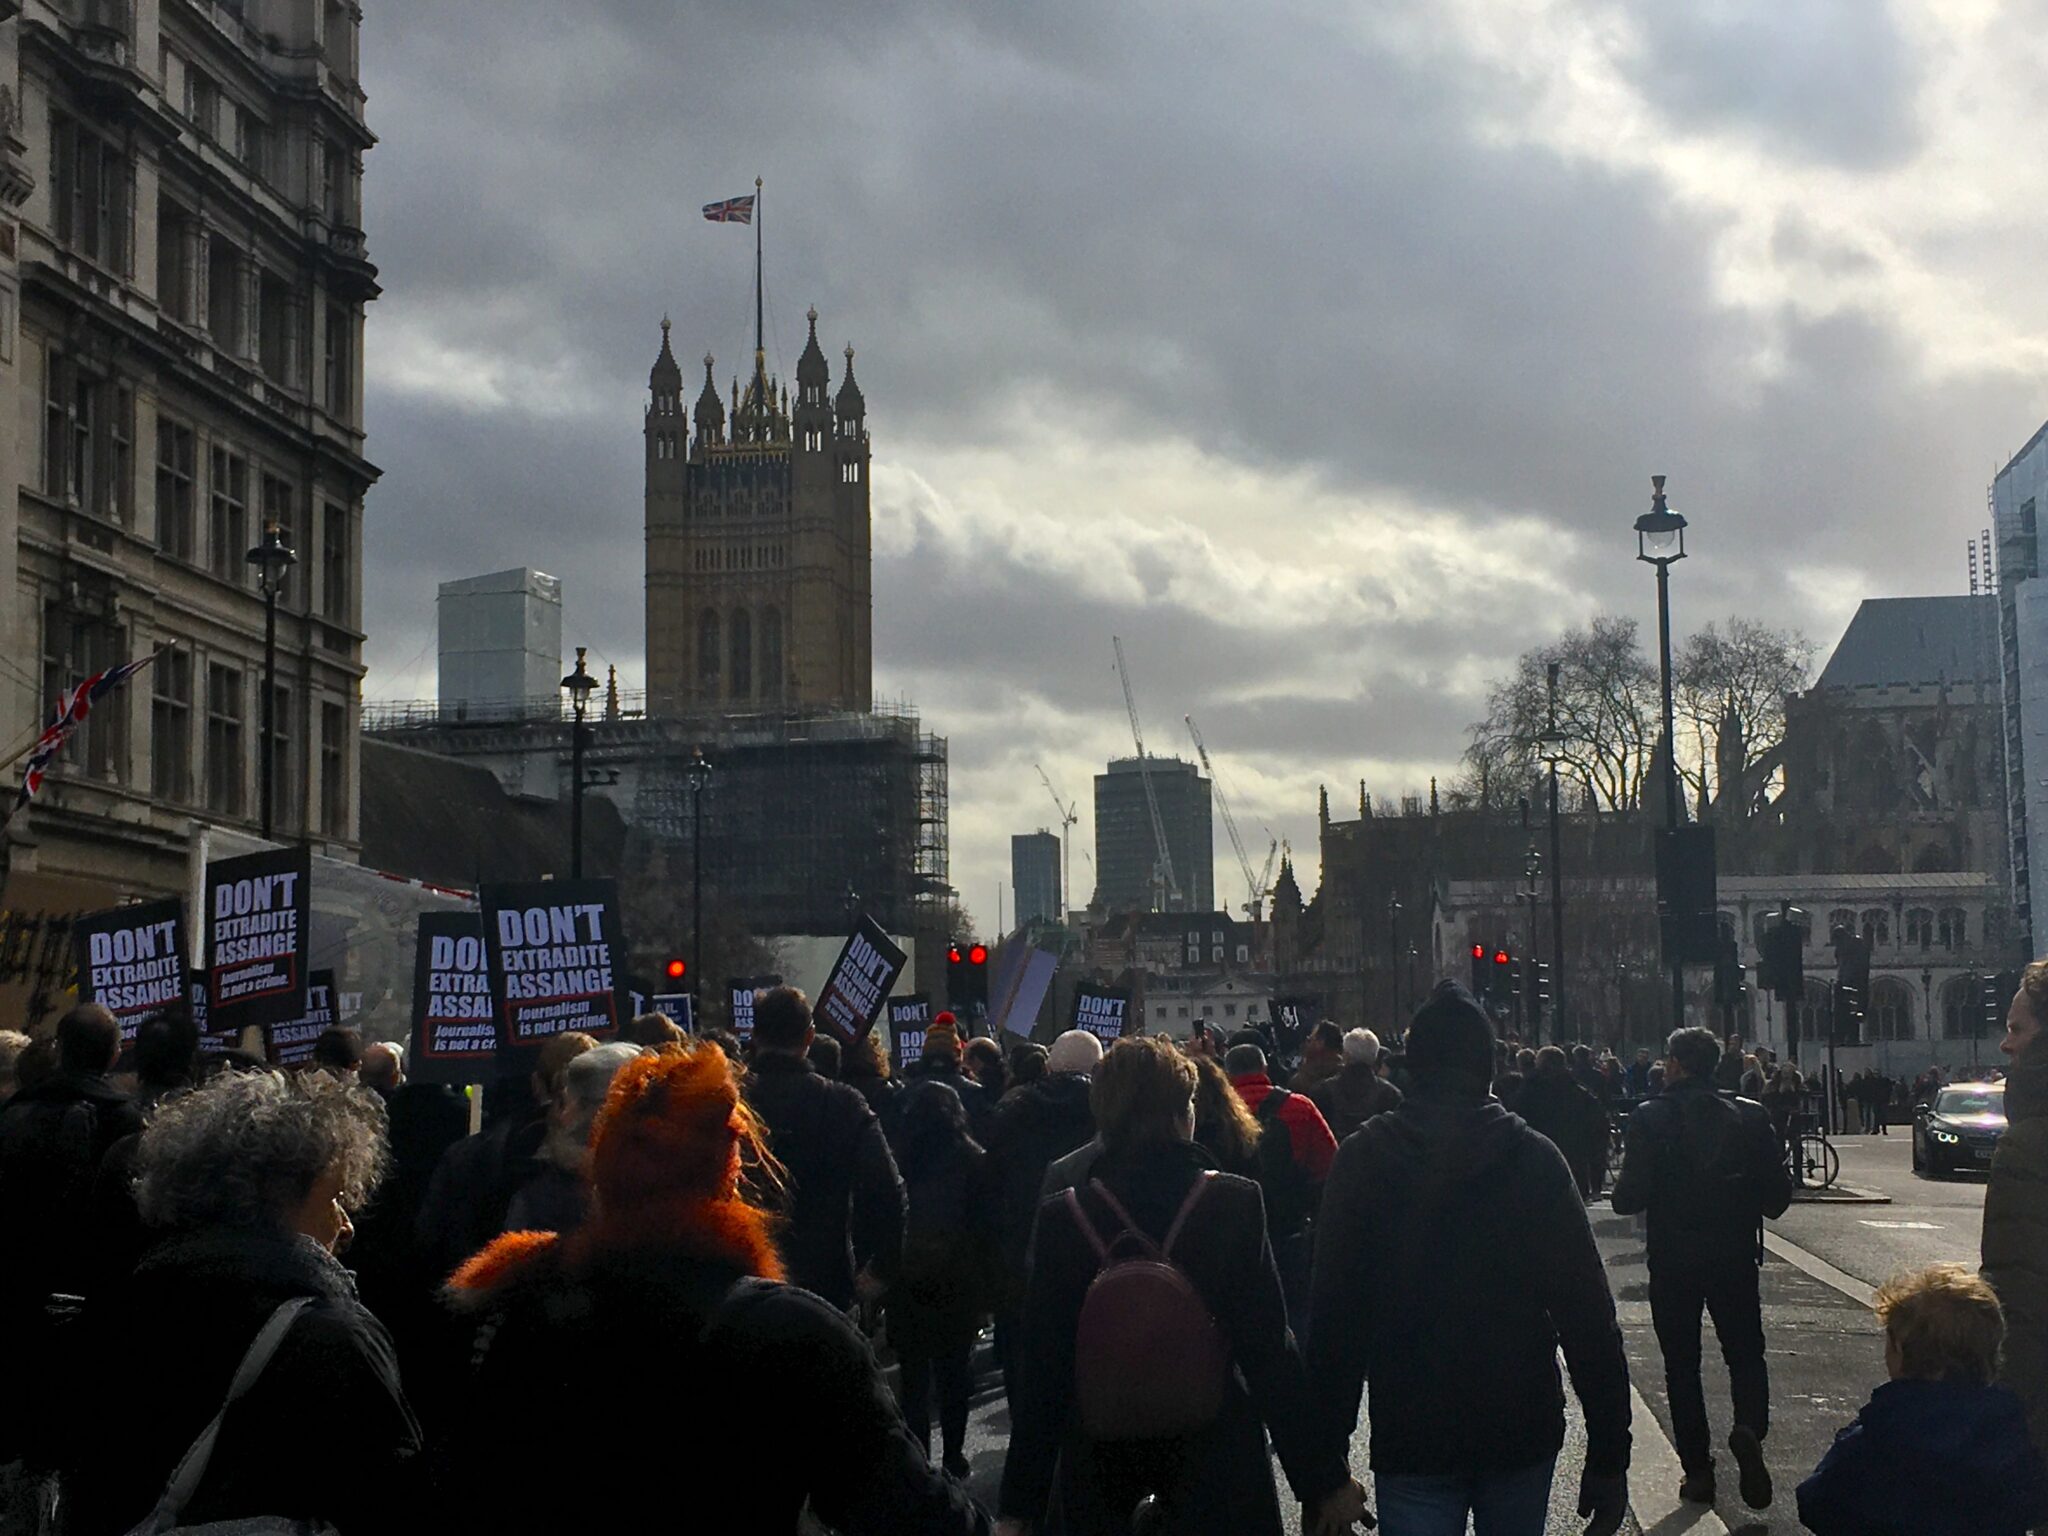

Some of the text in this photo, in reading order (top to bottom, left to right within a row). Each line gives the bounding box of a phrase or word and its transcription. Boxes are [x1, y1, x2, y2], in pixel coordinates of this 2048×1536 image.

[215, 872, 298, 919] DON'T
[215, 909, 297, 941] EXTRADITE
[497, 904, 604, 947] DON'T
[90, 919, 176, 967] DON'T
[215, 931, 297, 967] ASSANGE
[502, 944, 611, 972] EXTRADITE
[92, 955, 180, 987] EXTRADITE
[848, 931, 893, 987] DON'T
[95, 976, 182, 1010] ASSANGE
[429, 972, 491, 993] EXTRA
[506, 968, 614, 999] ASSANGE
[833, 971, 874, 1020] ASSANGE
[840, 956, 881, 1004] EXTRADITE
[428, 994, 493, 1018] ASSA
[518, 1001, 590, 1021] Journalism
[893, 1003, 928, 1022] DON'T
[1079, 995, 1126, 1016] DON'T
[435, 1023, 496, 1037] Journalis
[519, 1013, 610, 1036] is not a crime.
[434, 1040, 448, 1051] is
[448, 1038, 470, 1051] not
[471, 1039, 480, 1050] a
